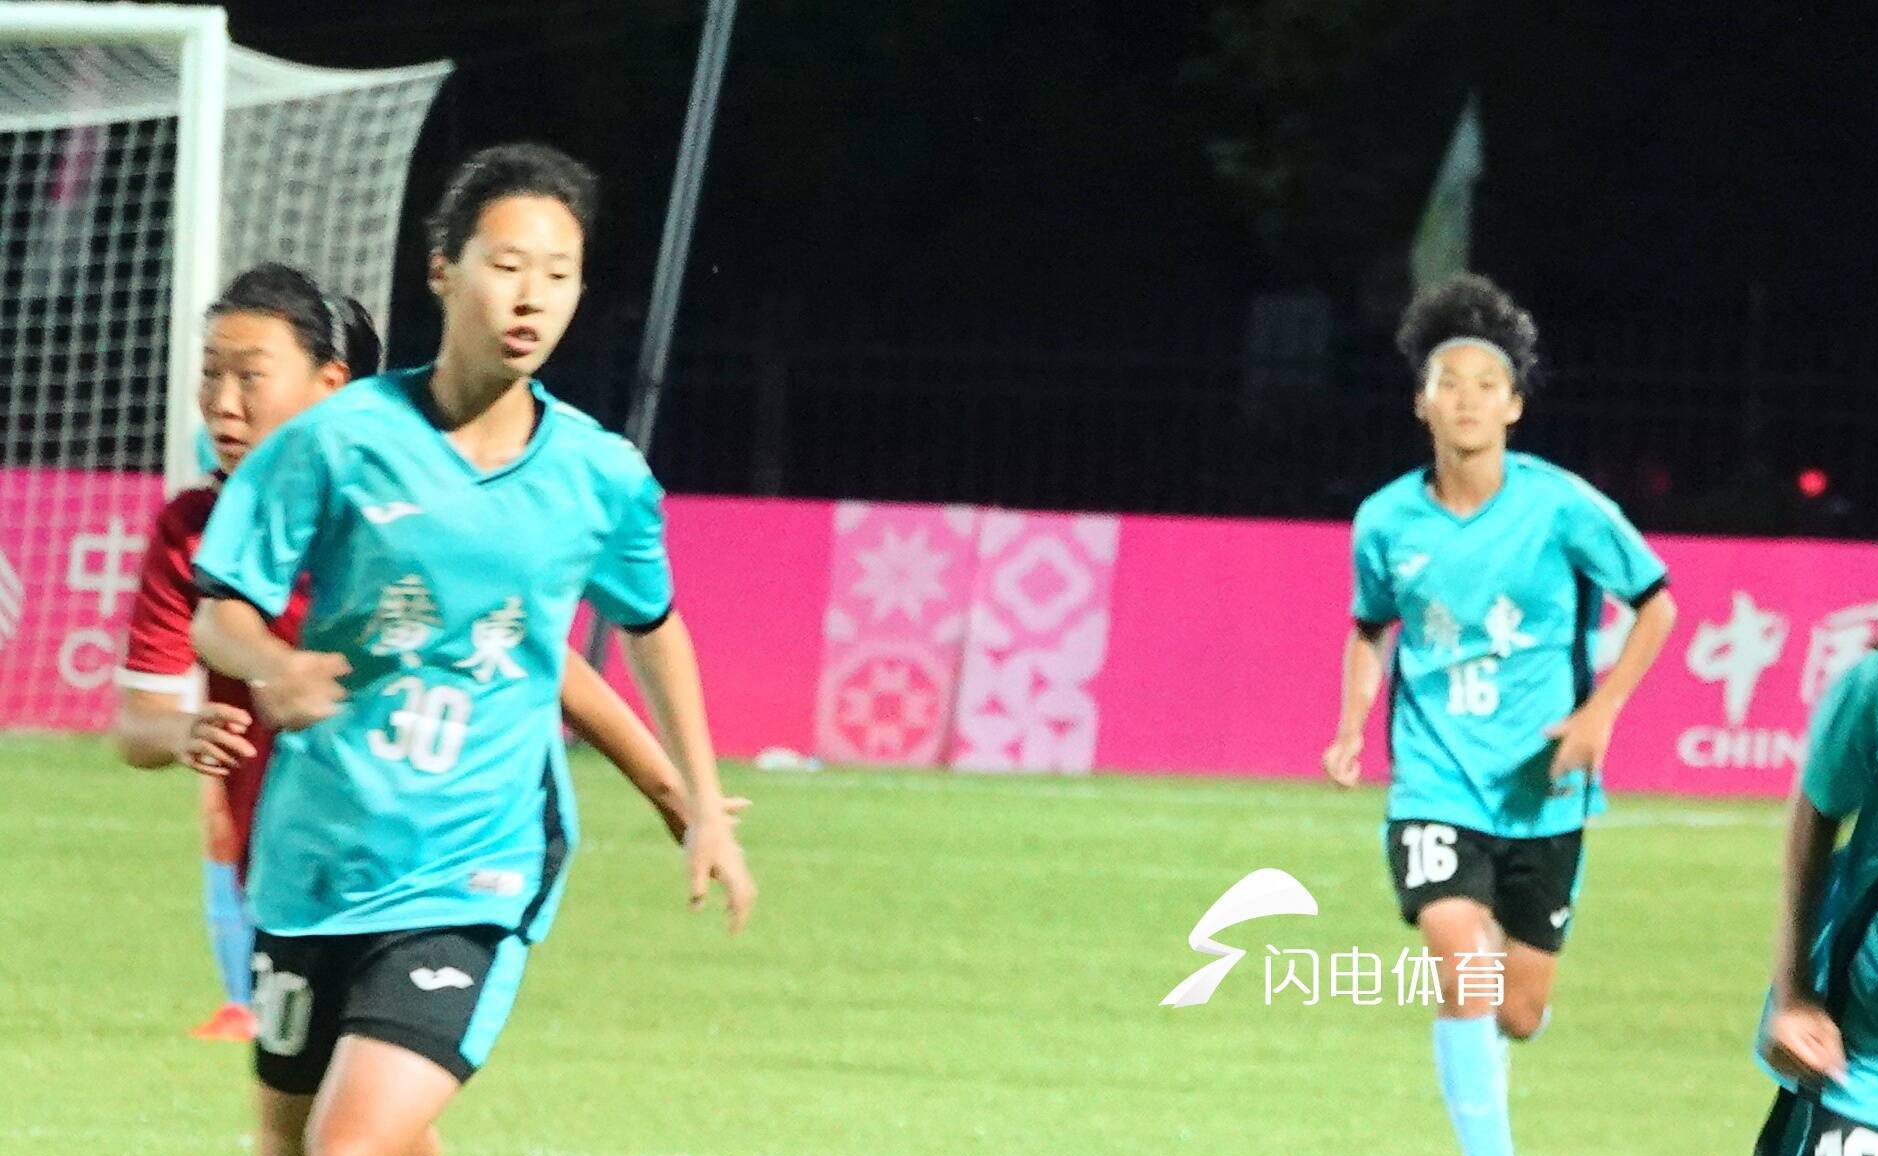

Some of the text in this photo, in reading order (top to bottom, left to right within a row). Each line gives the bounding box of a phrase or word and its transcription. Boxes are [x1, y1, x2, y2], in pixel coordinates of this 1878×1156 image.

[1446, 658, 1500, 718] 16
[366, 675, 472, 774] 30
[1402, 823, 1459, 889] 16
